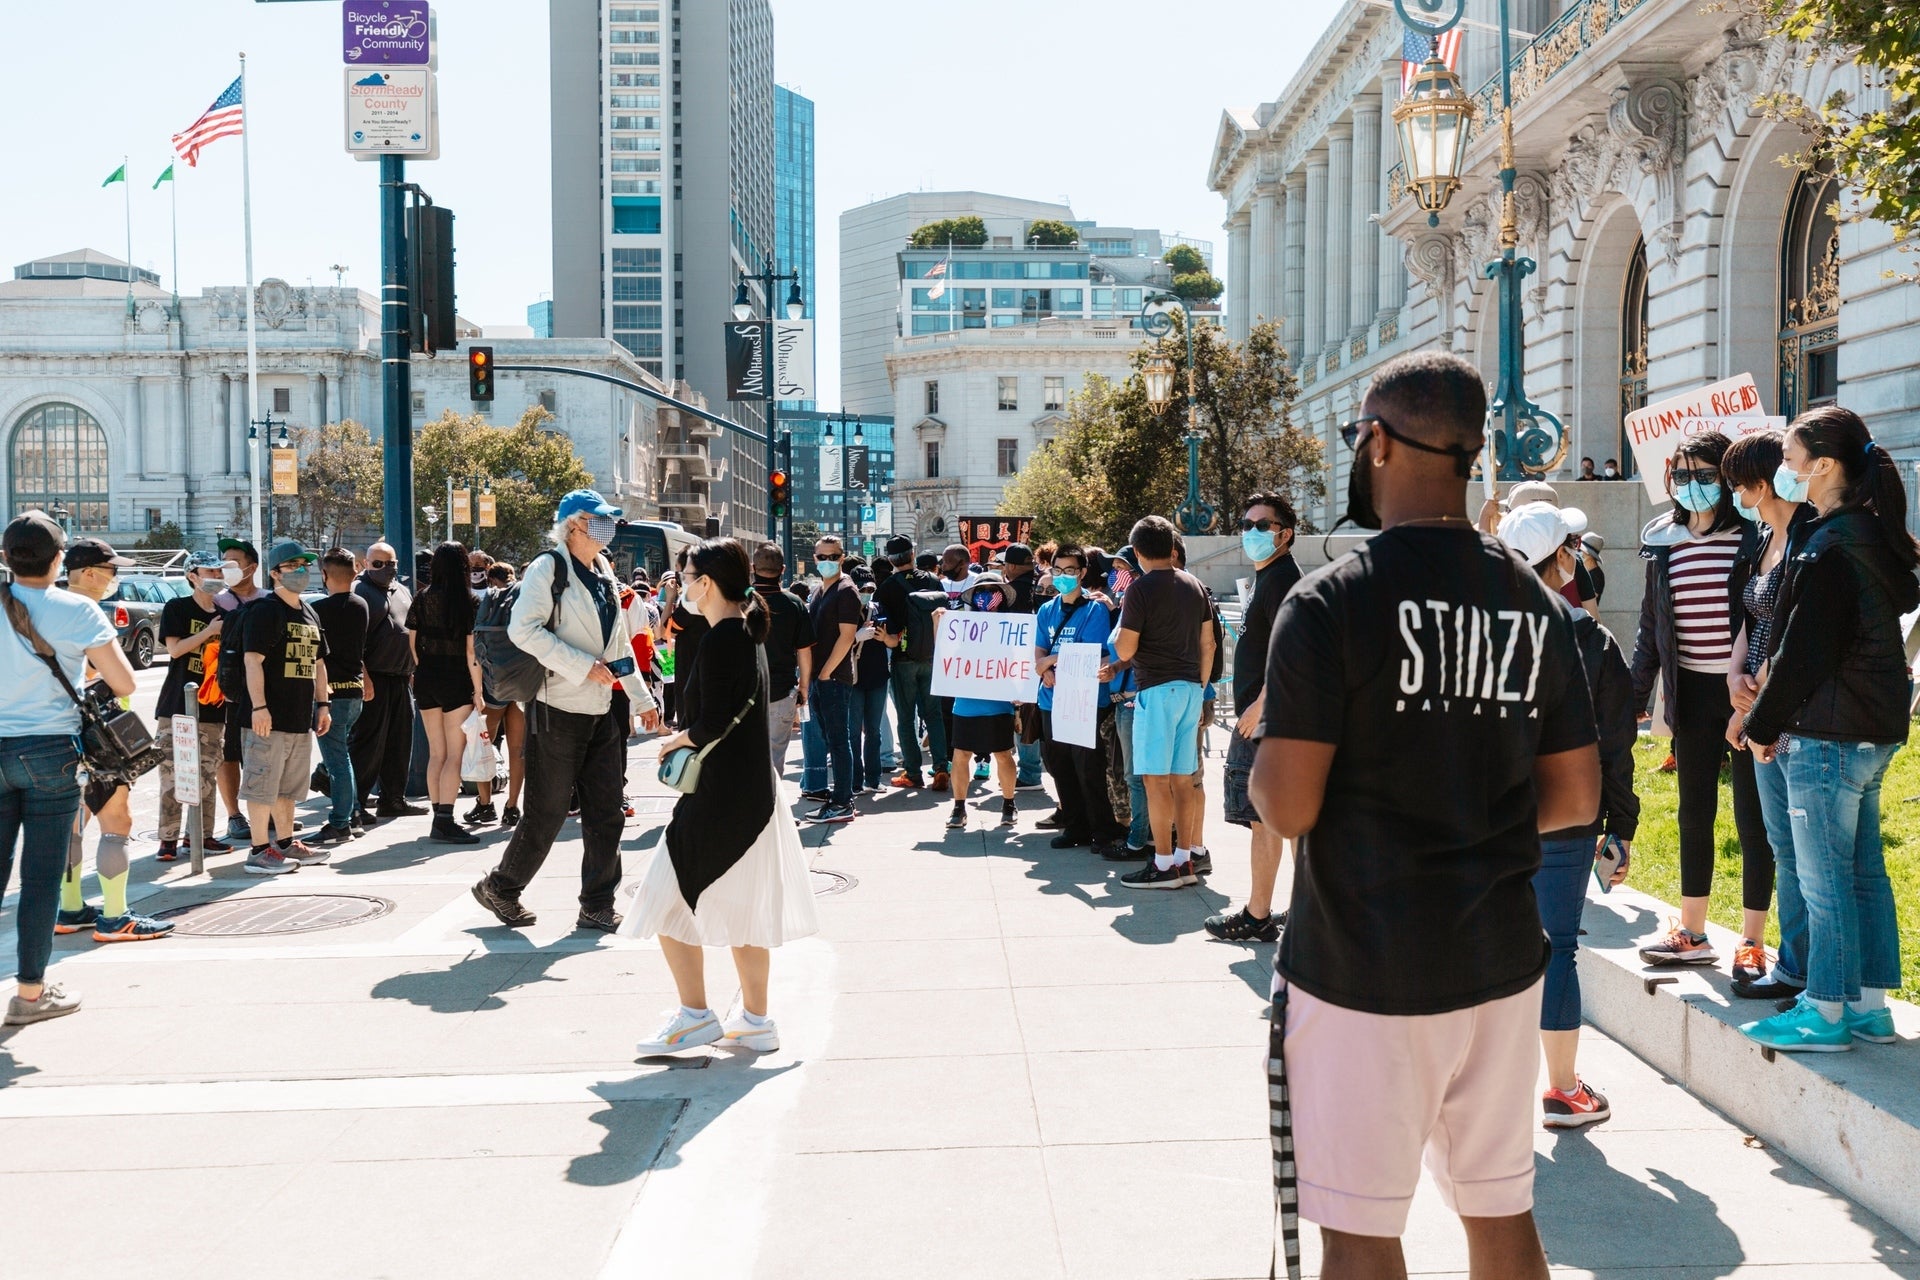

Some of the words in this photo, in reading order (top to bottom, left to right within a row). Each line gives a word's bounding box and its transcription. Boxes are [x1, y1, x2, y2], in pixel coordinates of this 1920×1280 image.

[348, 12, 387, 25] Bicycle
[355, 25, 409, 37] Friendly
[362, 38, 424, 51] Community
[351, 85, 424, 98] StormReady
[364, 98, 408, 111] County
[948, 619, 989, 643] STOP
[999, 621, 1029, 646] THE
[295, 664, 313, 677] ASIA
[943, 657, 1031, 680] VIOLENCE
[1395, 699, 1450, 713] BAY
